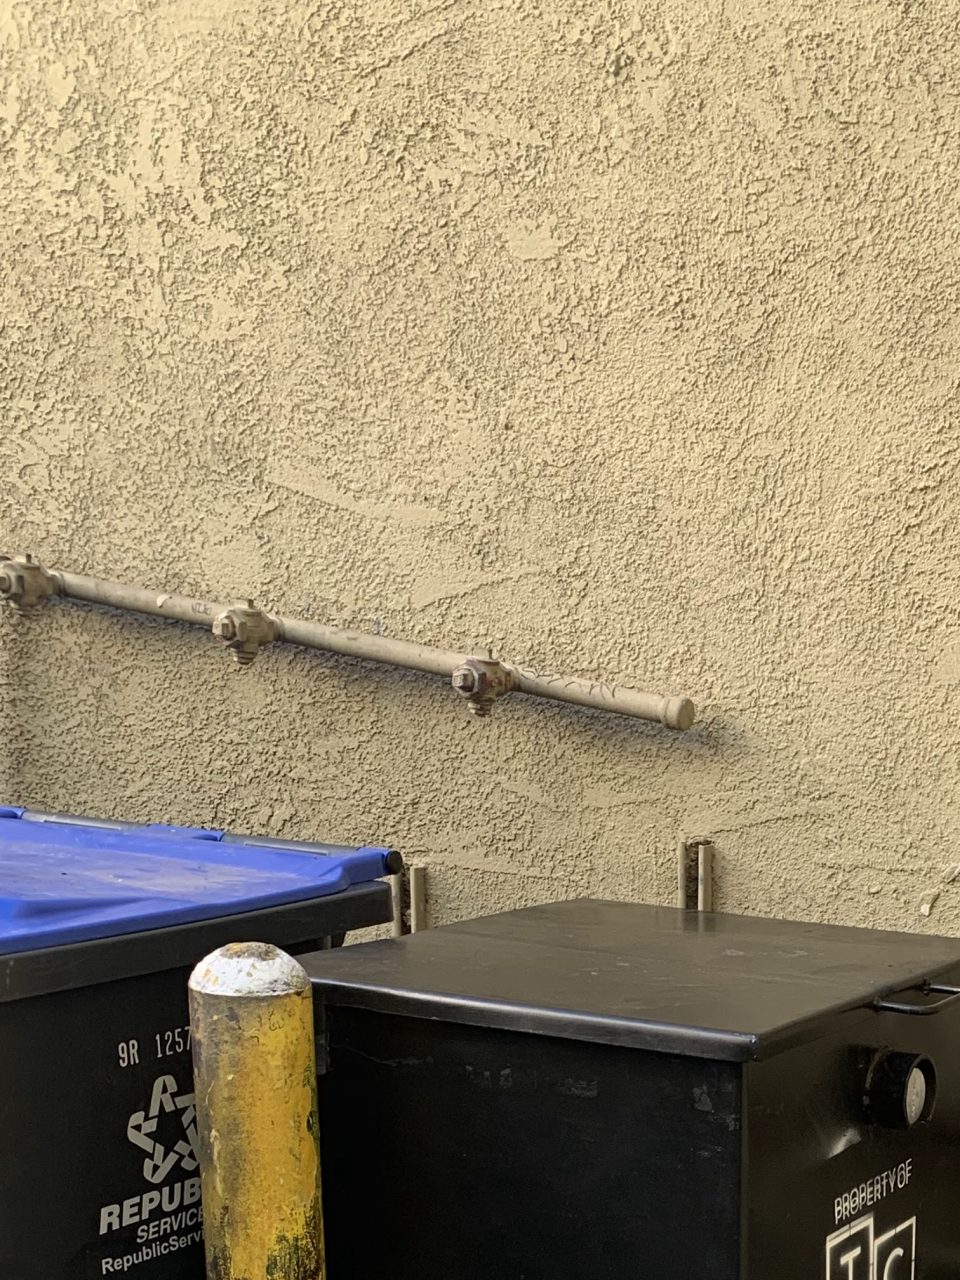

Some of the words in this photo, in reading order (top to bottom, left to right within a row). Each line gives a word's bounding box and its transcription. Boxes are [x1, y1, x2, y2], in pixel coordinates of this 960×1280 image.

[118, 1039, 139, 1068] 9R
[834, 1168, 897, 1225] PROPERTY
[897, 1158, 913, 1189] OF
